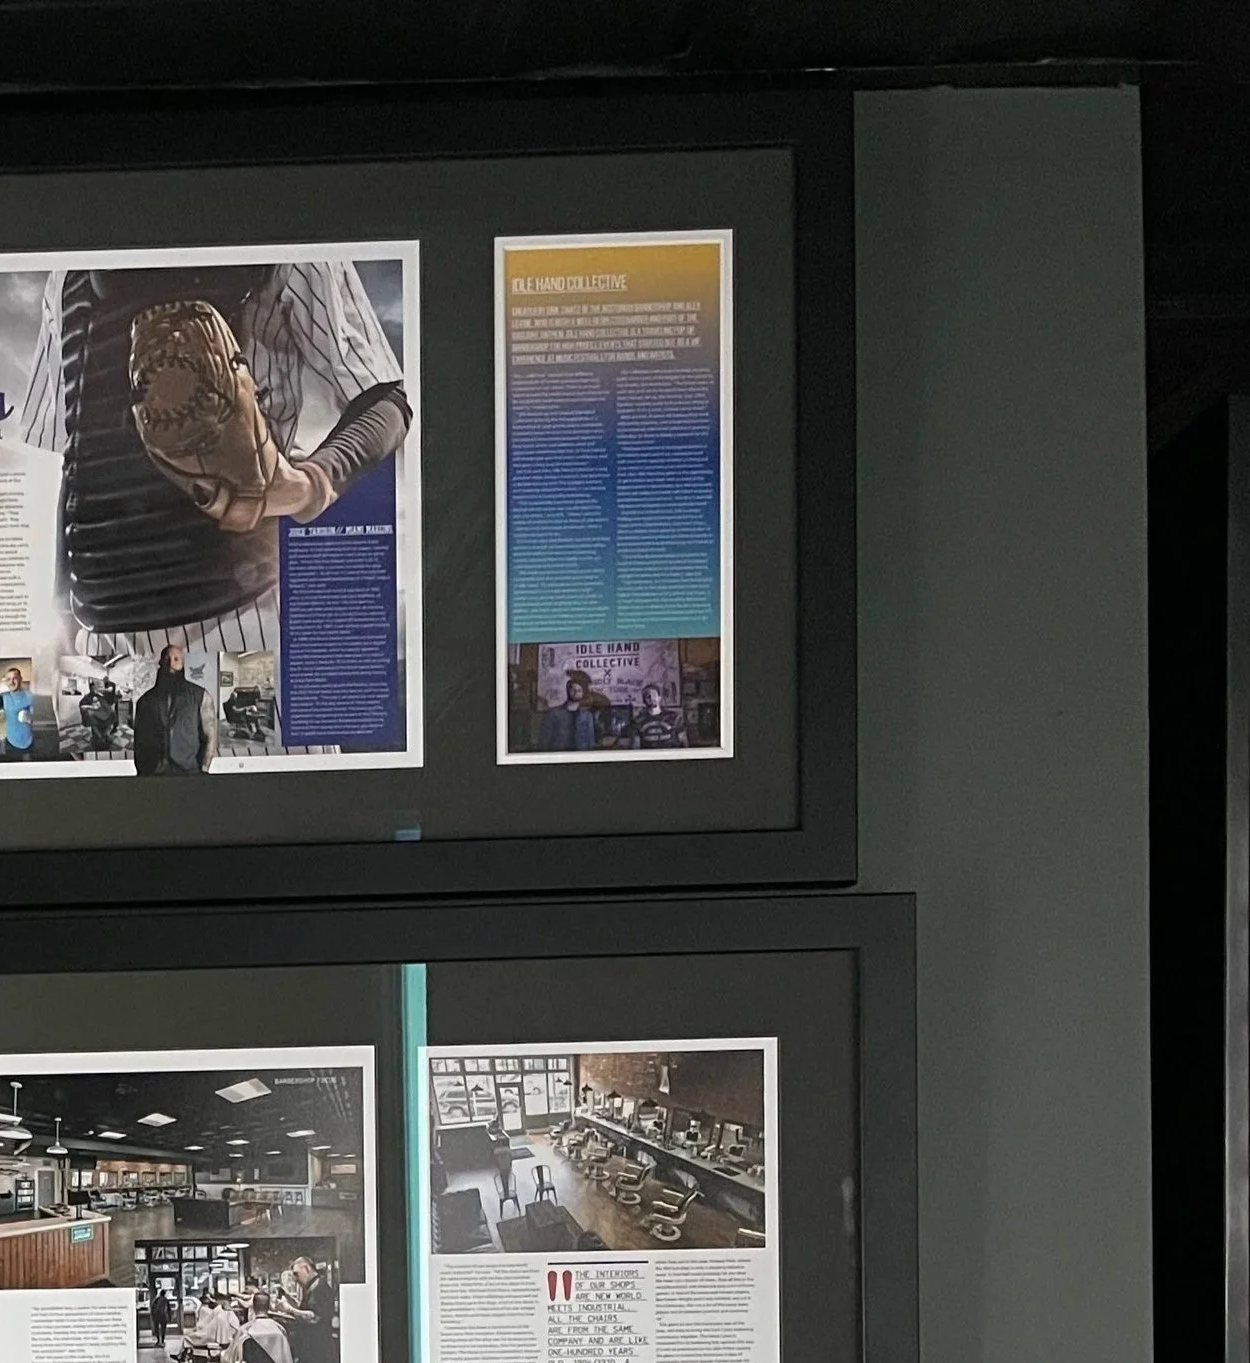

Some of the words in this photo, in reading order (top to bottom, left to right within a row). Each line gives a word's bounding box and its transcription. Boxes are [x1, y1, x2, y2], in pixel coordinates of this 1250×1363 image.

[512, 277, 534, 293] IDLE
[536, 276, 565, 292] HAND
[567, 274, 627, 291] COLLECTIVE
[576, 644, 603, 655] IDLE
[607, 642, 640, 653] HAND
[575, 657, 640, 669] COLLECTIVE
